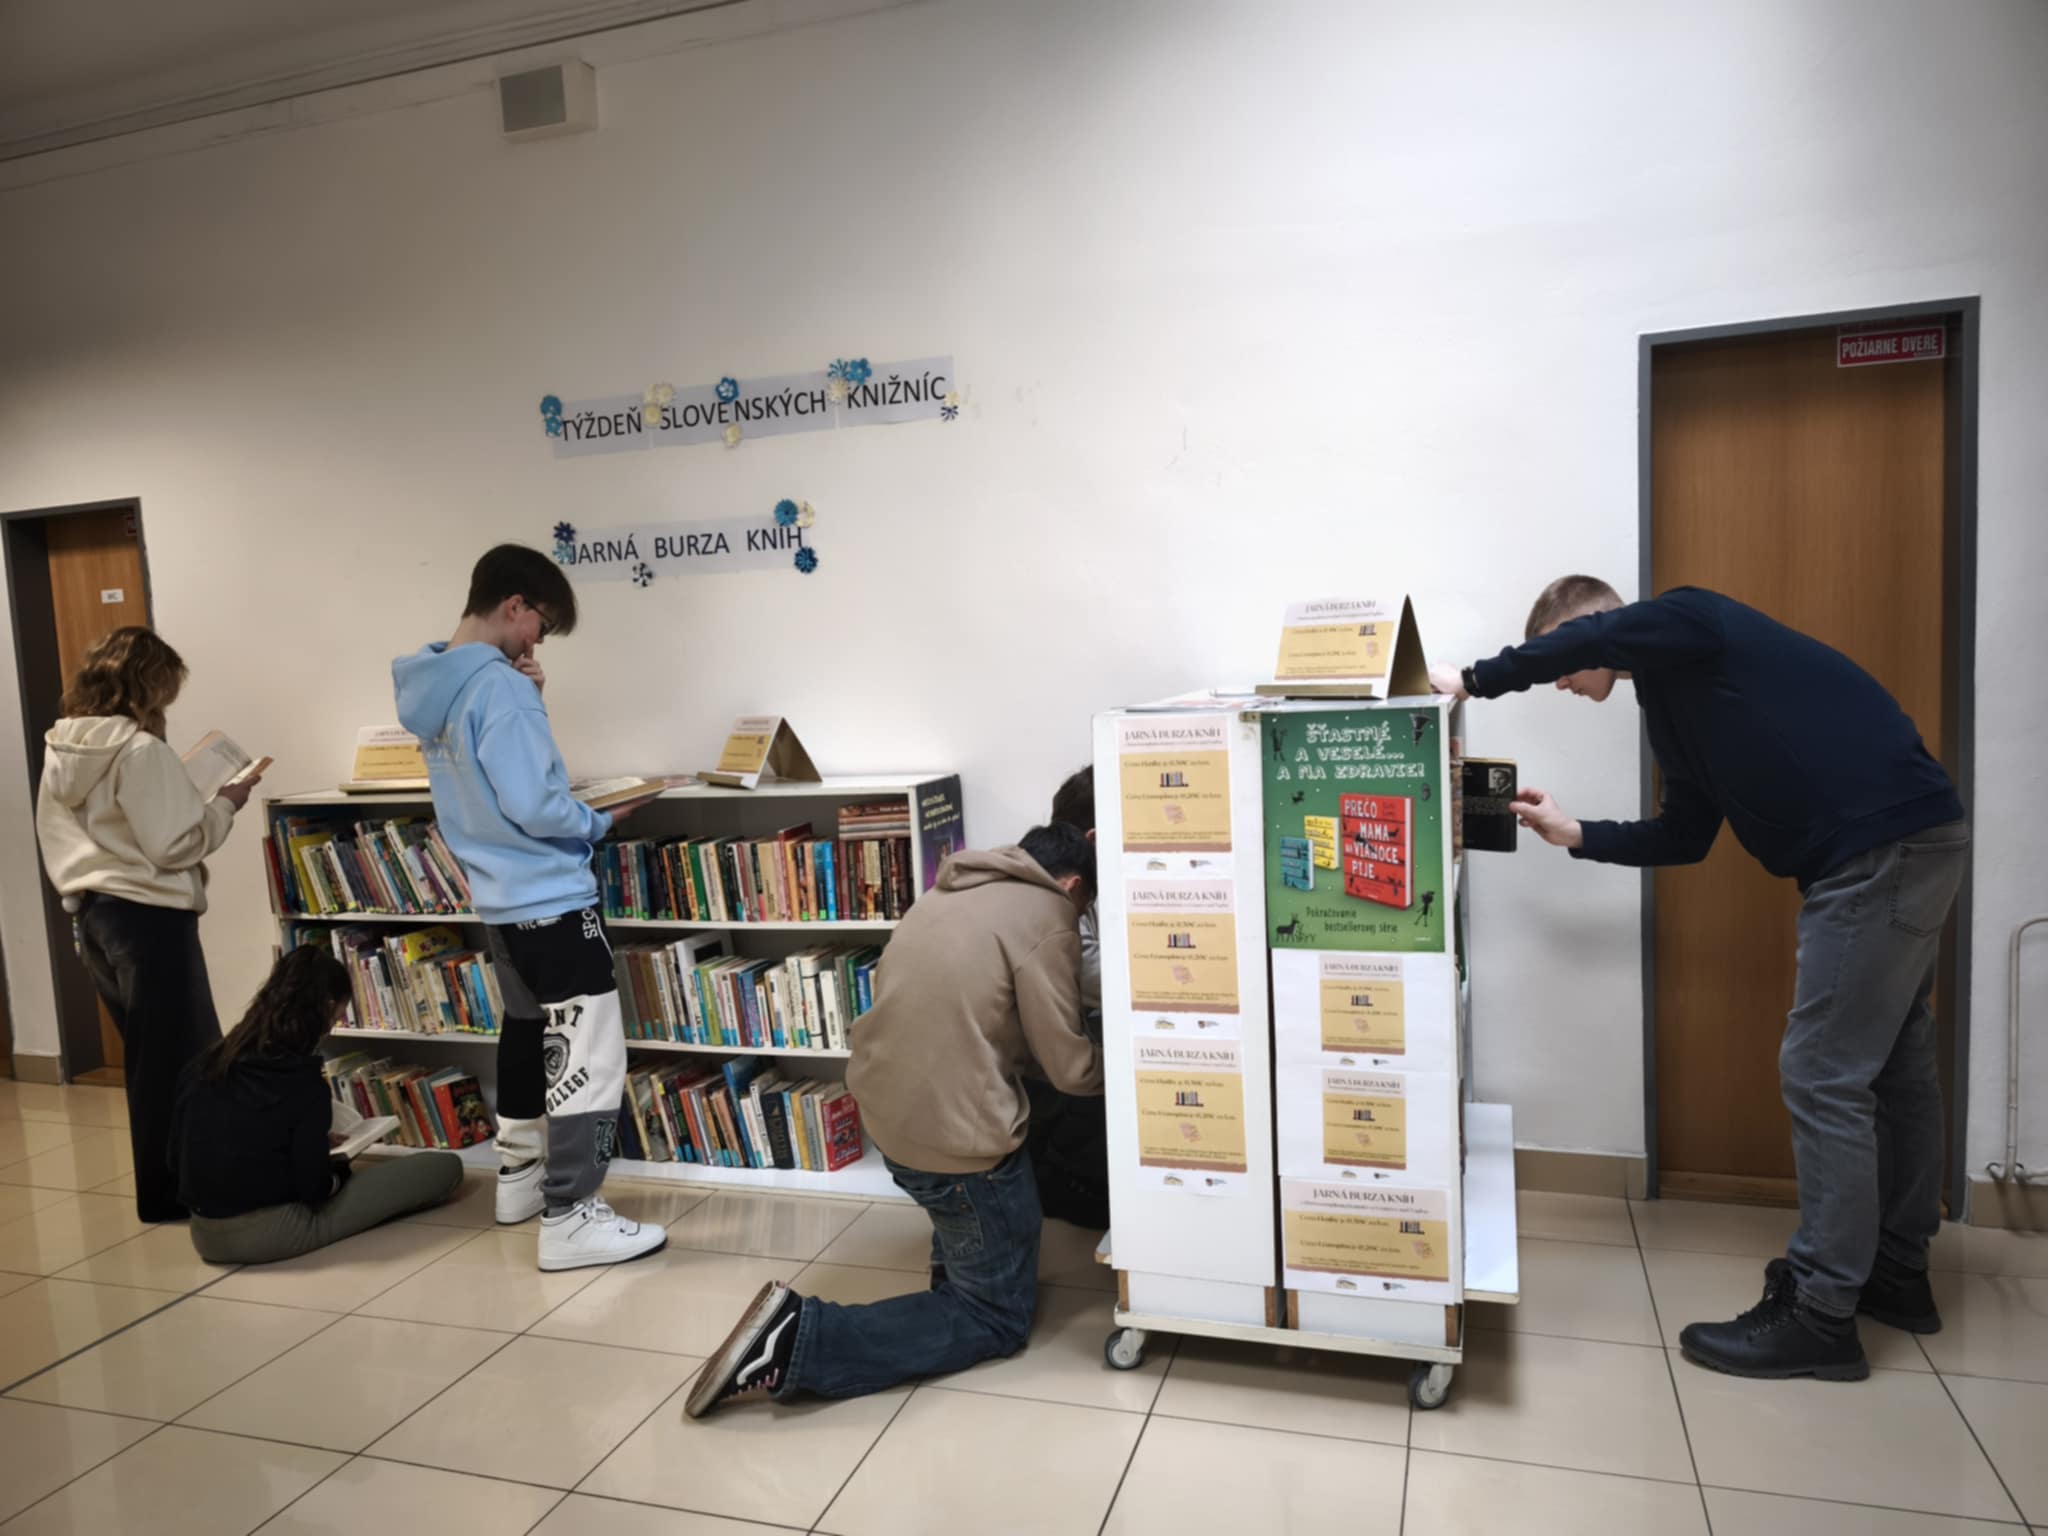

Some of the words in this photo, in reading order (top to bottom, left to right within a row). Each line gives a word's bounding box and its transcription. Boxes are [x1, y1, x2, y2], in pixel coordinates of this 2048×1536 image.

[1902, 334, 1938, 352] DVERE
[562, 406, 642, 441] TÝŽDEŇ
[660, 387, 826, 430] SLOVENSKÝCH
[847, 371, 946, 409] KNIŽNÍC
[570, 533, 639, 565] JARNÁ
[655, 532, 730, 559] BURZA
[1295, 748, 1309, 762] A
[1276, 766, 1291, 780] A
[1344, 797, 1378, 818] PREČO
[1360, 822, 1390, 842] MAMA
[1352, 859, 1375, 879] PIJE
